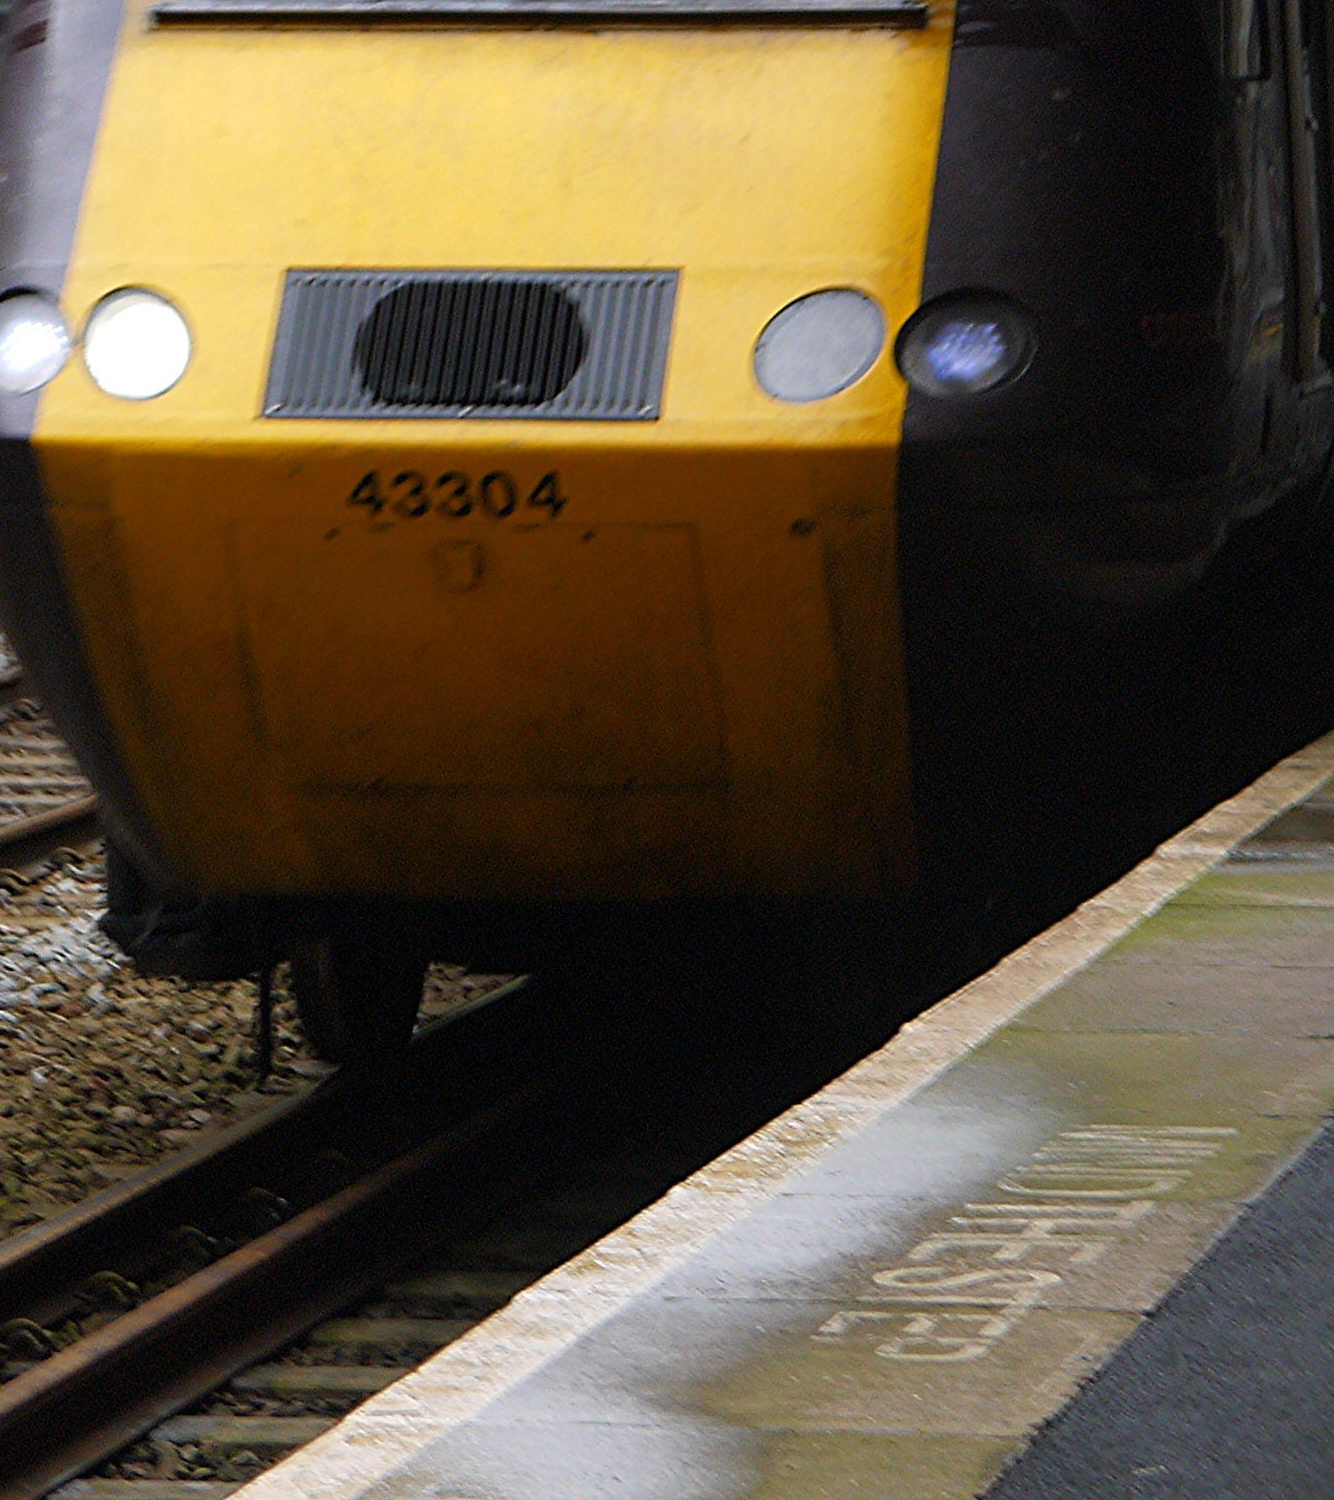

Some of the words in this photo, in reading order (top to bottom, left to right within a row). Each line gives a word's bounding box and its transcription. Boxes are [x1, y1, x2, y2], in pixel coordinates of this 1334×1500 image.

[347, 469, 567, 519] 43304
[905, 1199, 1157, 1263] THE
[811, 1264, 1063, 1362] STEP
